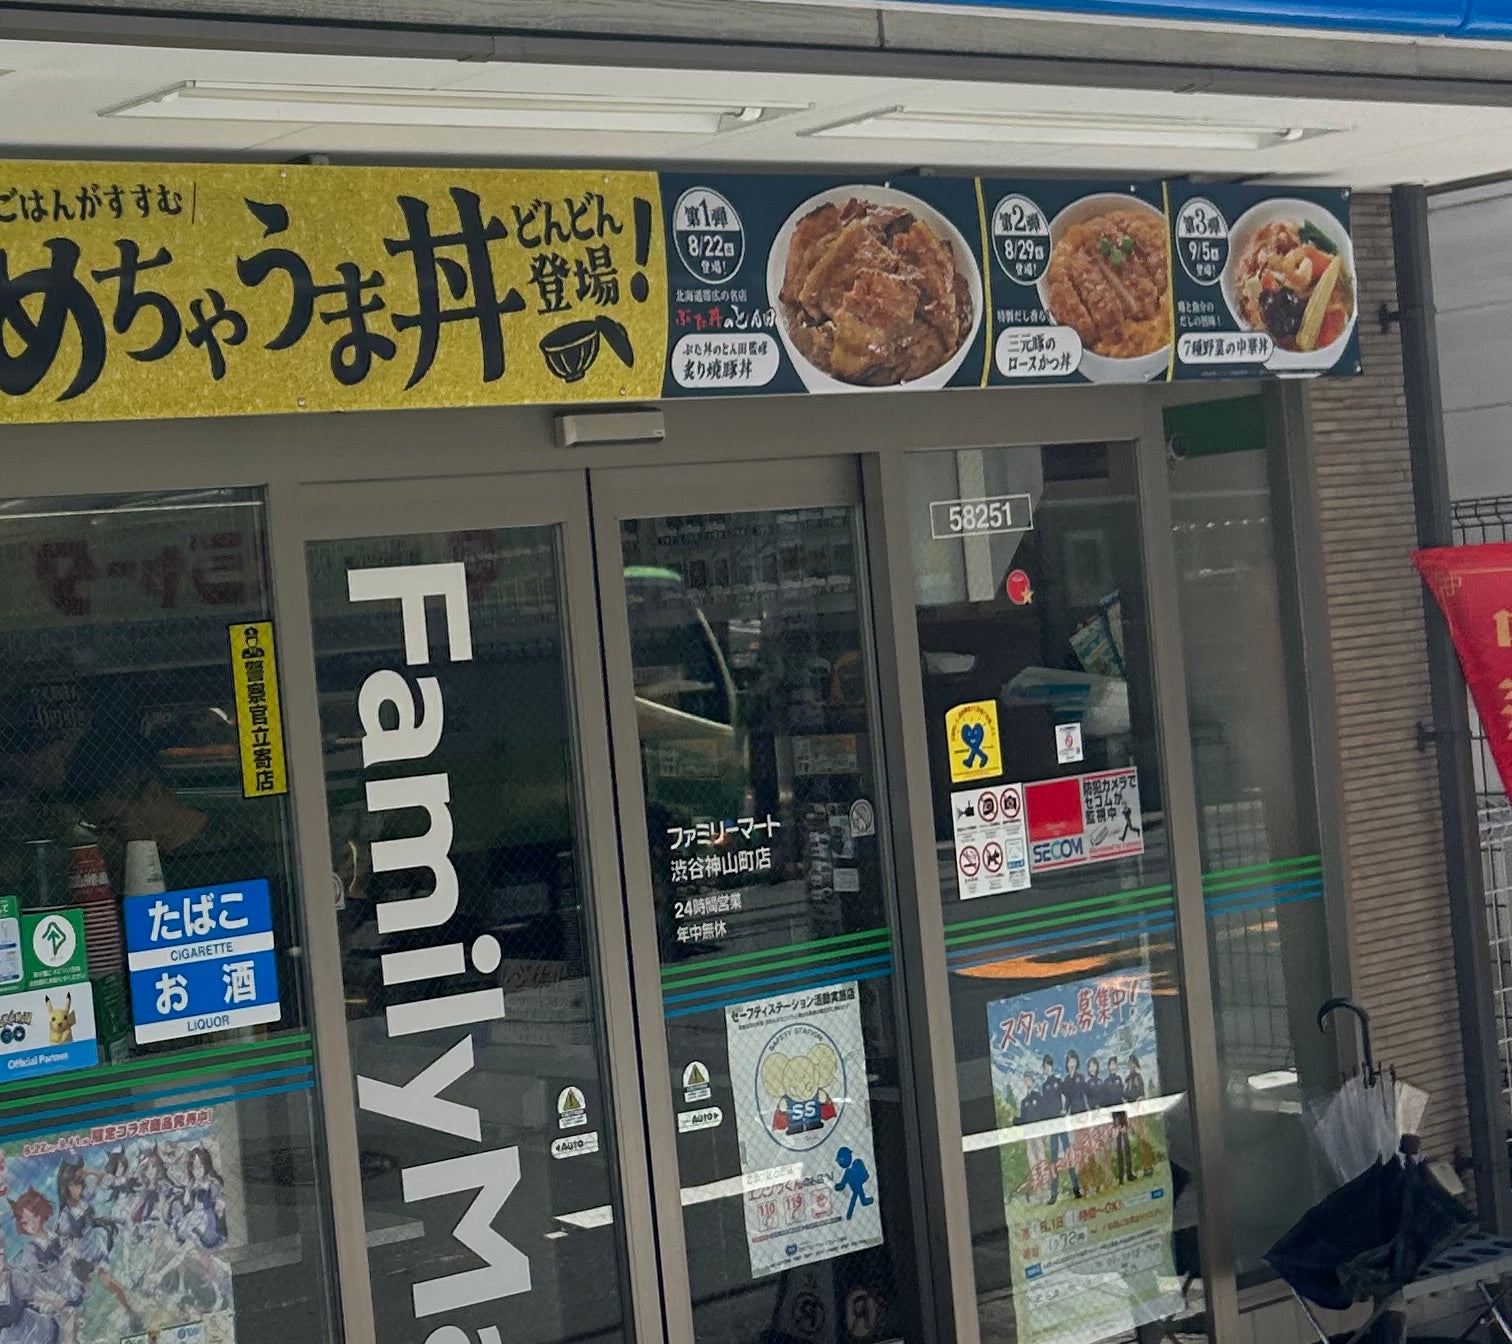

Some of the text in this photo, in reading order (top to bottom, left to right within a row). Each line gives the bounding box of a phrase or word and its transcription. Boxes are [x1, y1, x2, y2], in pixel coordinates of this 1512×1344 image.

[512, 191, 624, 250] どんどん
[948, 502, 1013, 532] 58251
[666, 813, 782, 850] ファミリーマート
[1032, 837, 1084, 863] SECOM
[670, 846, 772, 883] 渋谷神山町店
[148, 892, 250, 942] たばこ
[674, 891, 743, 919] 24時間営業
[676, 920, 728, 944] 年中無休
[169, 941, 235, 963] CIGARETTE
[186, 1013, 232, 1033] LIQUOR
[7, 1051, 70, 1071] Official Partner
[691, 1112, 714, 1125] AUTO
[792, 1100, 817, 1122] SS
[560, 1139, 585, 1152] AUTO
